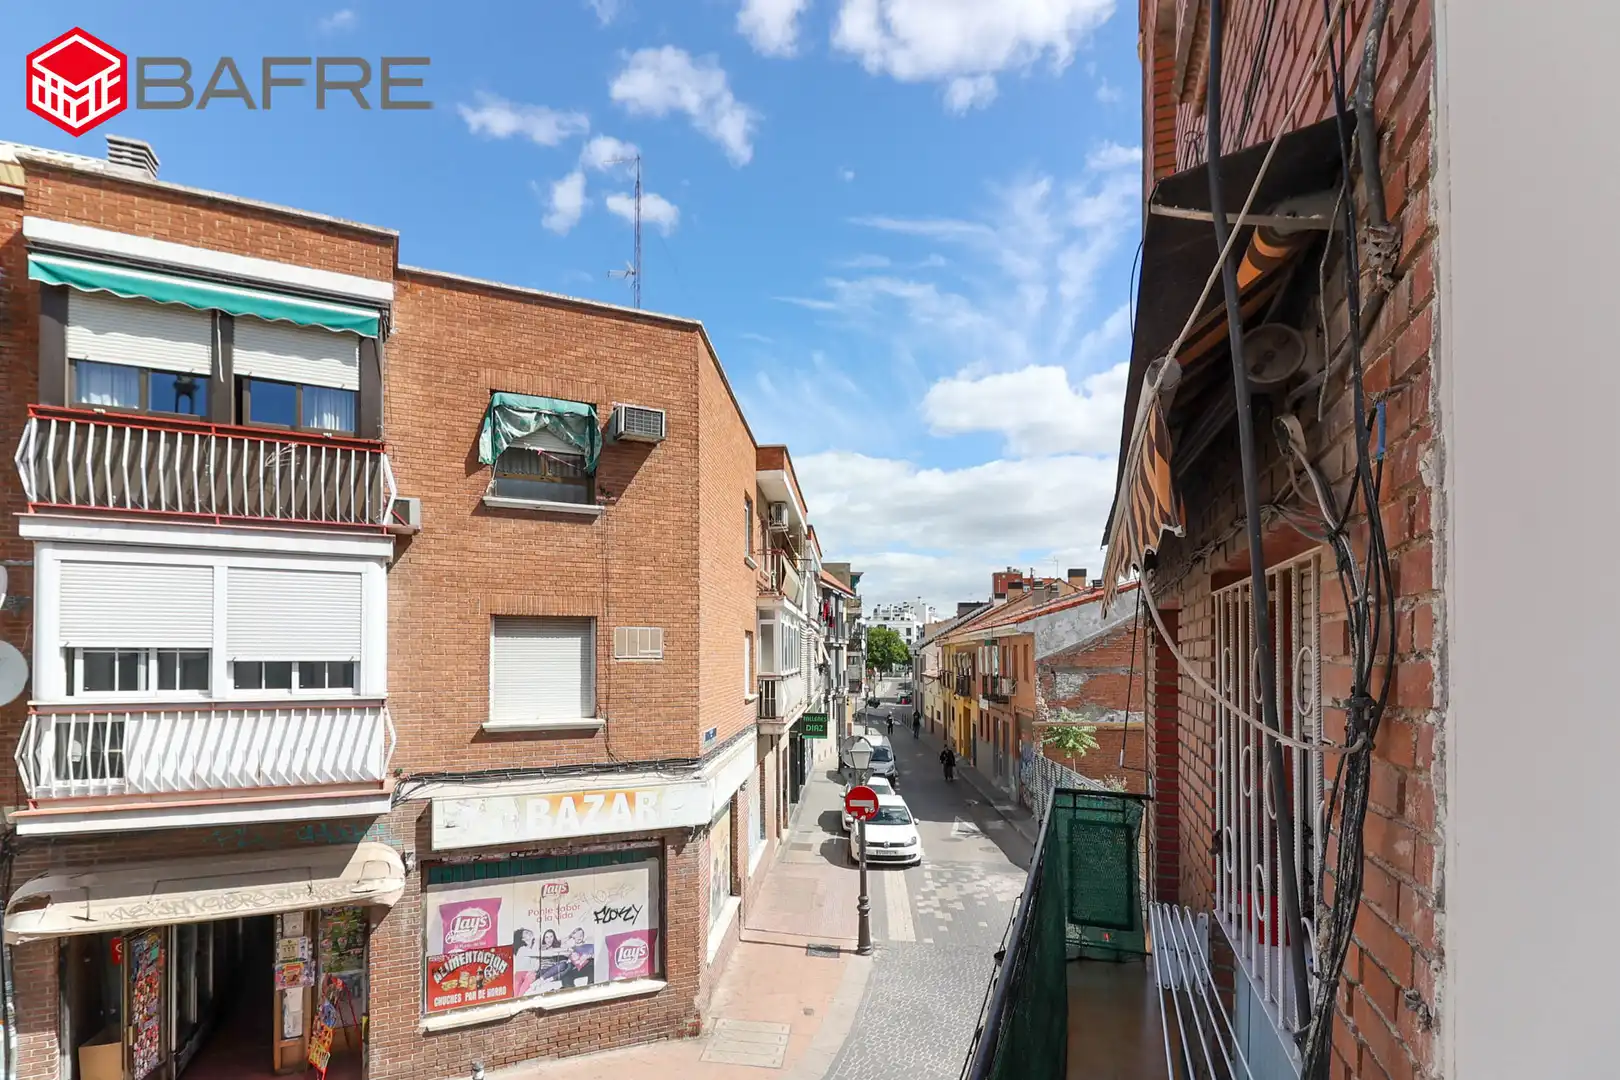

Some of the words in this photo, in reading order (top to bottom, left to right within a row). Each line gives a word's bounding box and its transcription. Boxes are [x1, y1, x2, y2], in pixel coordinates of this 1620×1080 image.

[806, 724, 824, 732] DIAZ
[525, 790, 659, 832] BAZAR
[528, 907, 554, 917] Ponte
[544, 914, 553, 922] la
